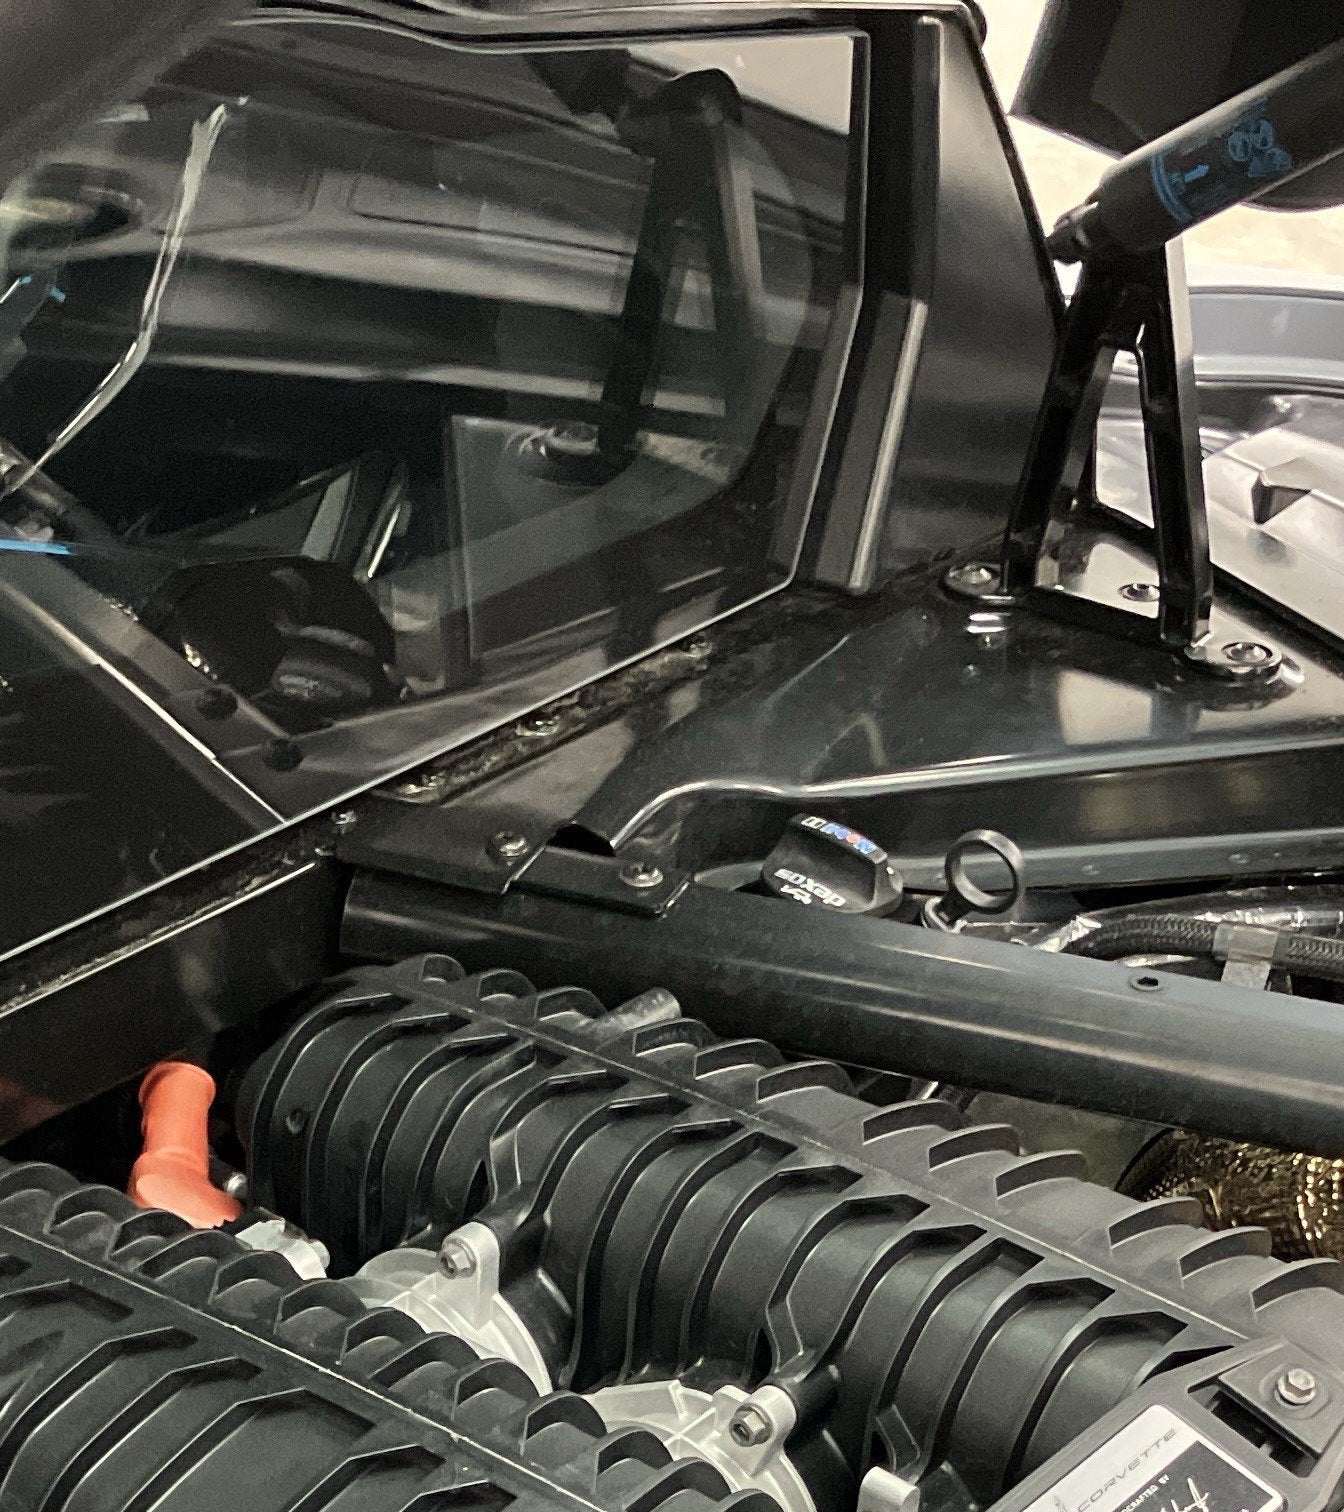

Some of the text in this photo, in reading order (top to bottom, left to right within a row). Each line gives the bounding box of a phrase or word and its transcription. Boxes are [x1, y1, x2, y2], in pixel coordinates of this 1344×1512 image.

[774, 869, 846, 907] dexos
[1078, 1429, 1175, 1512] CORVETTE
[1158, 1474, 1169, 1484] BY
